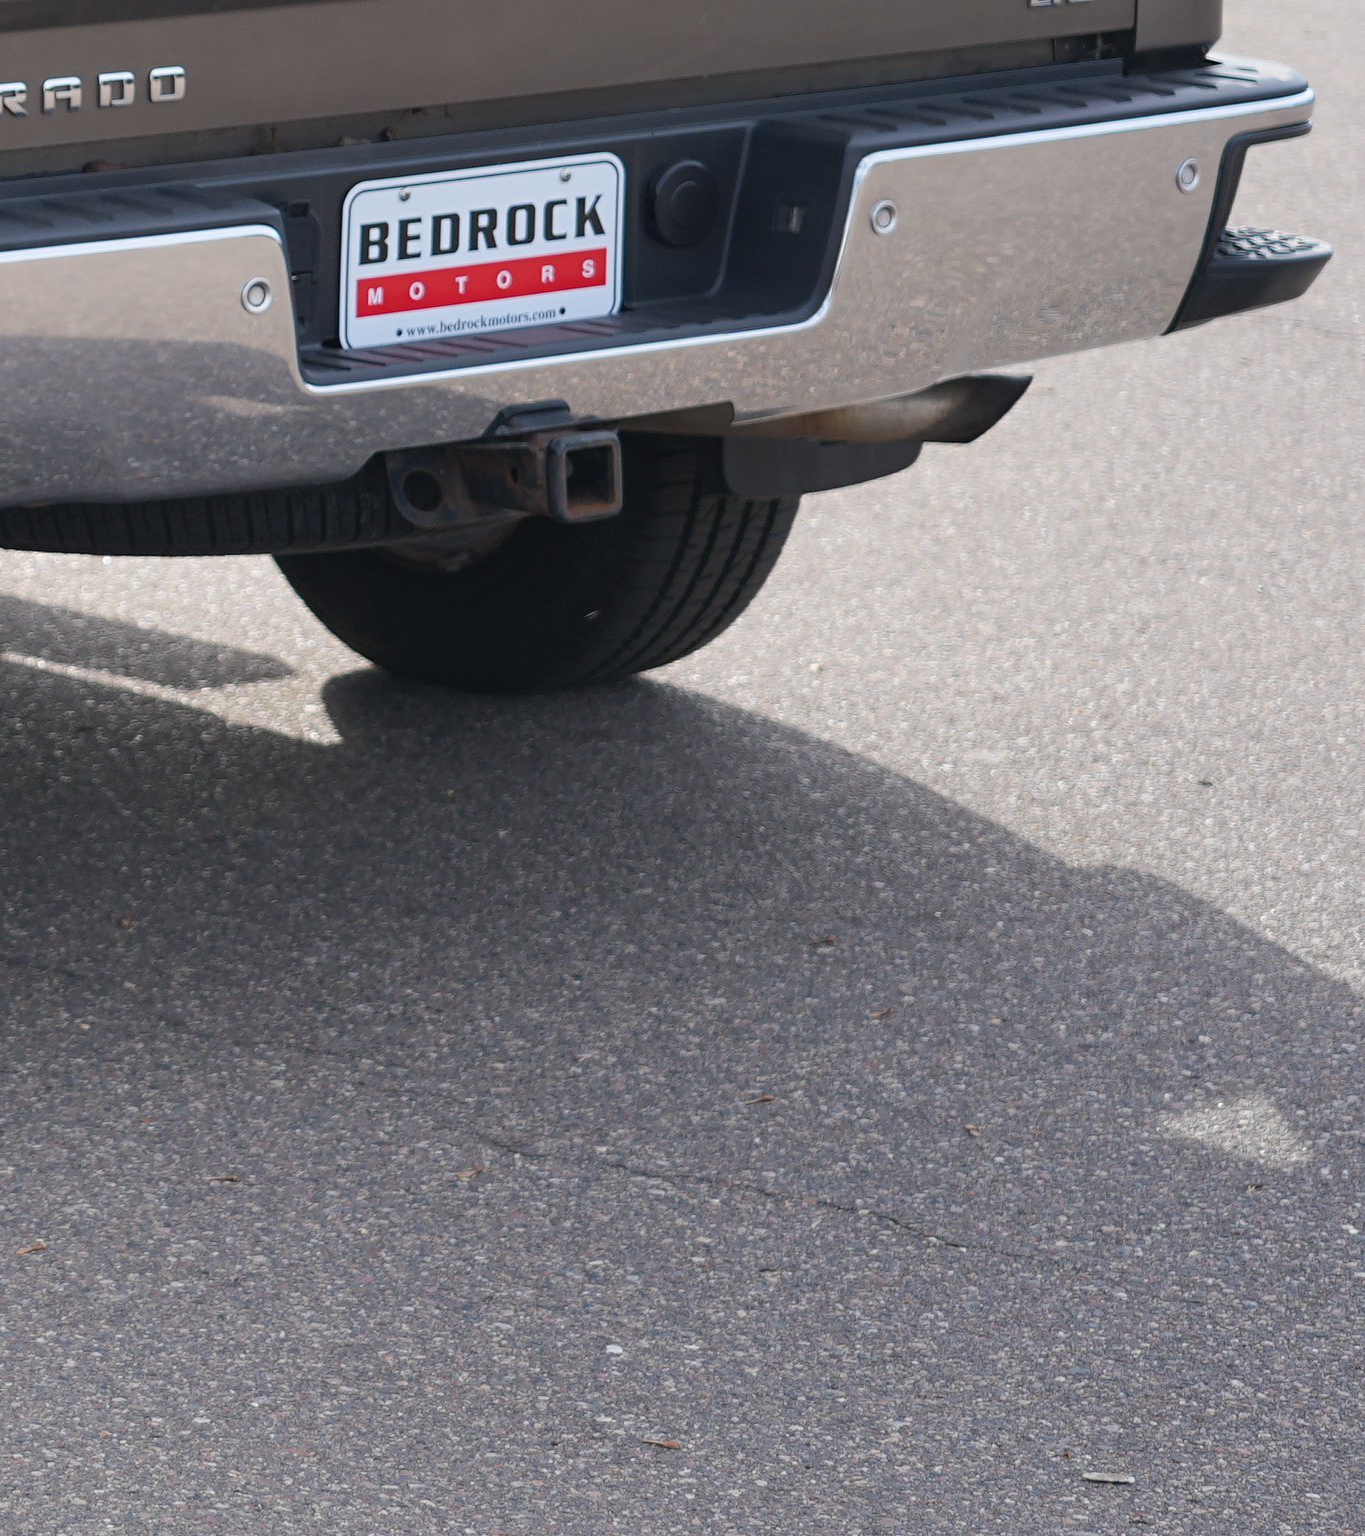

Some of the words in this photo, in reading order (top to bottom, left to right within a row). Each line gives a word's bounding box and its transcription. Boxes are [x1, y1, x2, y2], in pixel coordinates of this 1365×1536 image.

[358, 193, 606, 266] BEDROCK
[367, 258, 596, 306] MOTORS
[405, 308, 557, 338] www.bedrockmotors.com
